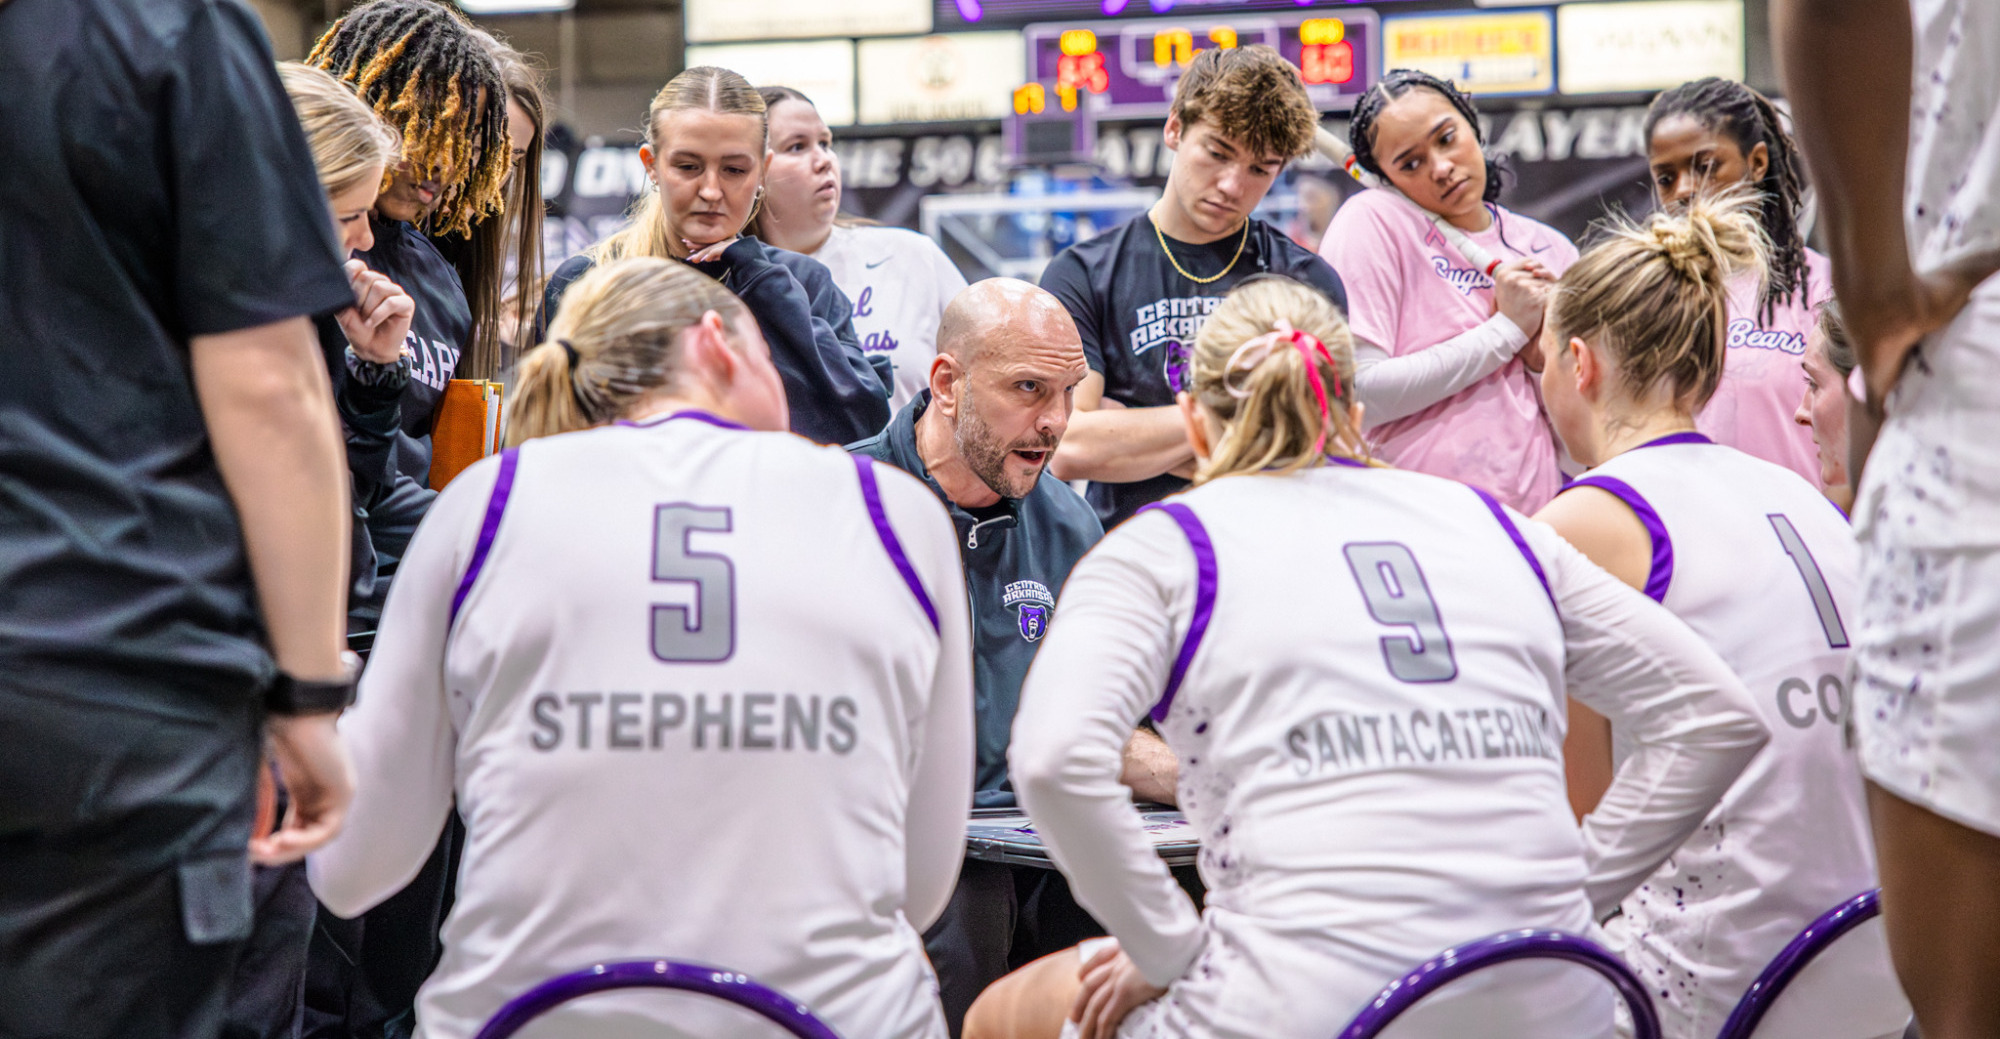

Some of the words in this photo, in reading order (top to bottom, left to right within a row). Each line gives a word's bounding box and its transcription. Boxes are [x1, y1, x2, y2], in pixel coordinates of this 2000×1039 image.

[1136, 296, 1228, 326] CENTR
[1726, 317, 1806, 356] Bears
[650, 501, 736, 665] 5
[1004, 580, 1049, 595] CENTRAL
[1341, 541, 1459, 684] 9
[1766, 513, 1850, 649] 1
[529, 691, 859, 756] STEPHENS
